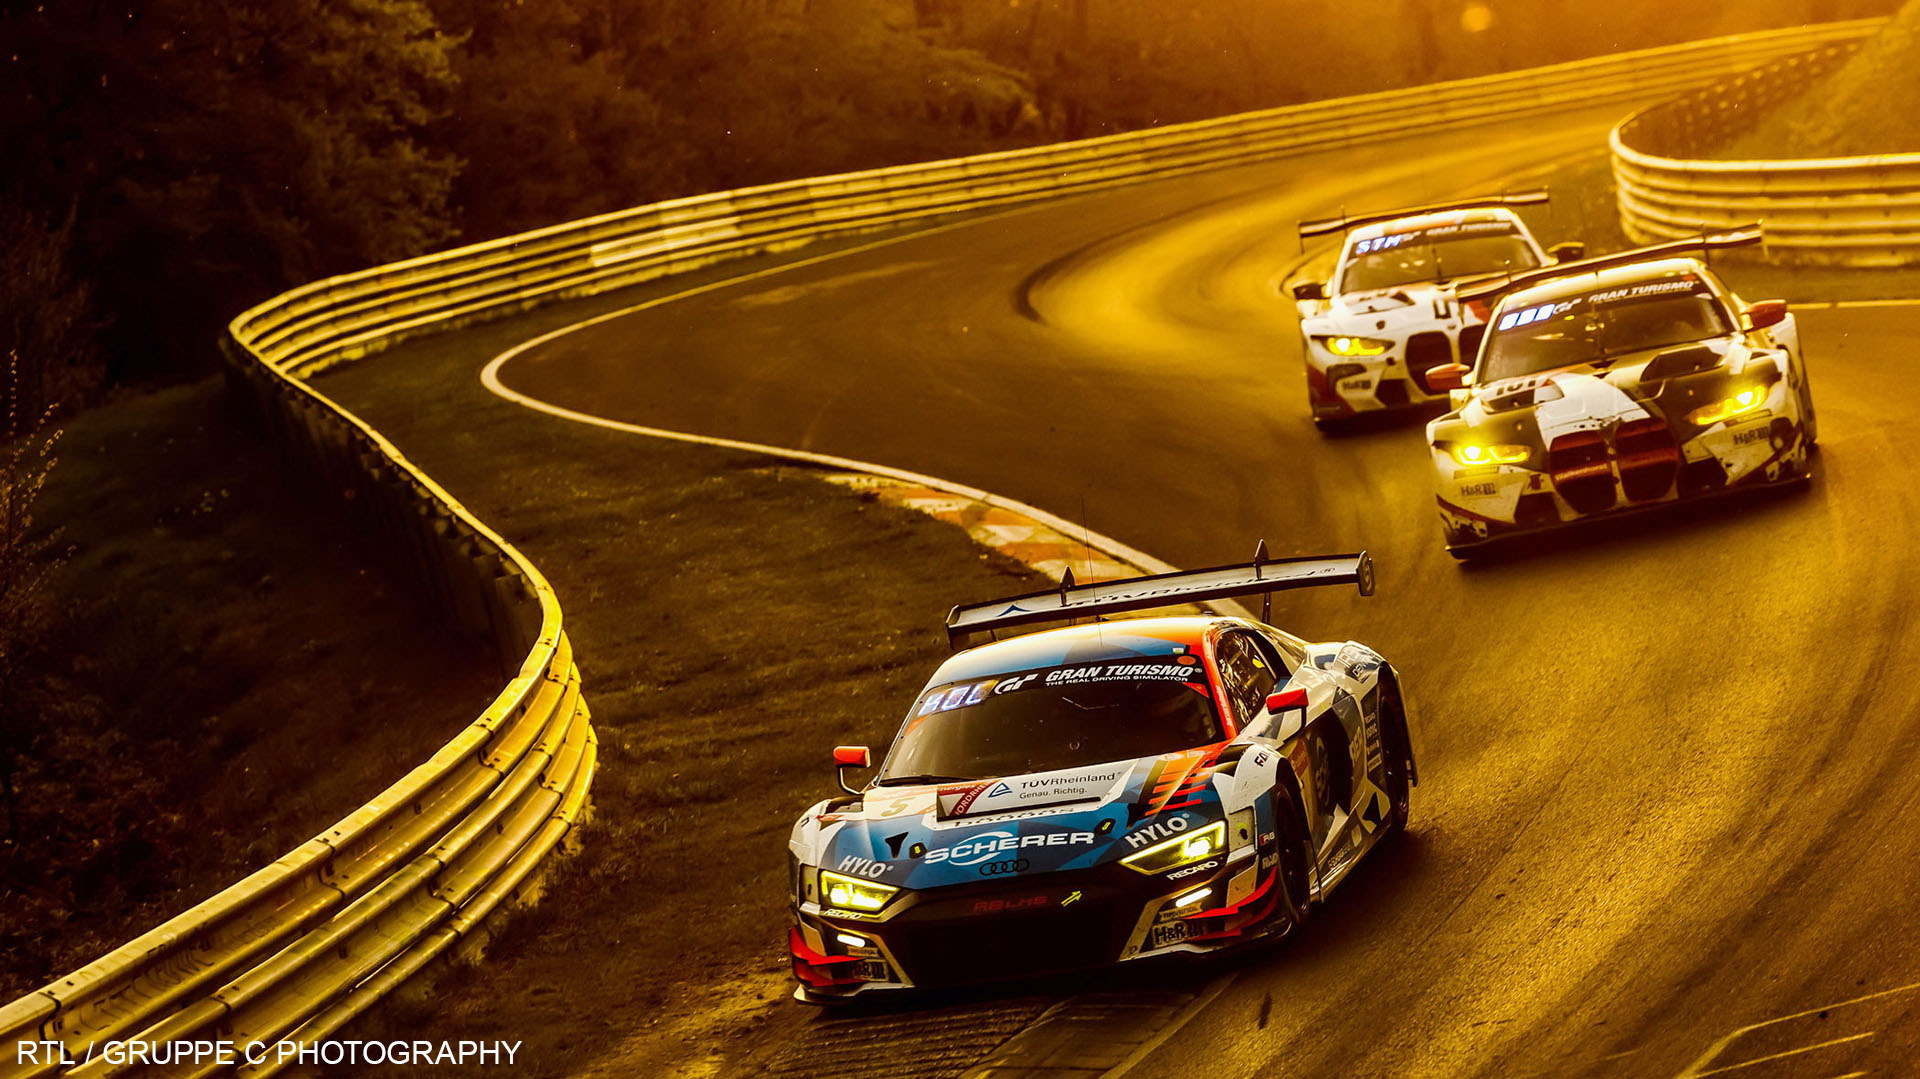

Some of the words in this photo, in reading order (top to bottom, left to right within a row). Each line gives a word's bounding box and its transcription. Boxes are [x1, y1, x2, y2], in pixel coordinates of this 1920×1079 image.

[1588, 289, 1627, 303] GRAN
[1631, 280, 1695, 296] TURISMO
[1045, 668, 1098, 682] GRAN
[1105, 664, 1194, 677] TURISMO
[1132, 674, 1189, 682] SIMULATOR
[1019, 791, 1051, 800] Genau.
[1053, 787, 1088, 797] Richtig.
[1125, 816, 1189, 849] HYLO
[923, 831, 1096, 865] SCHERER
[838, 855, 885, 878] HYLO
[1166, 860, 1219, 881] RECARO
[1154, 922, 1187, 945] H&R
